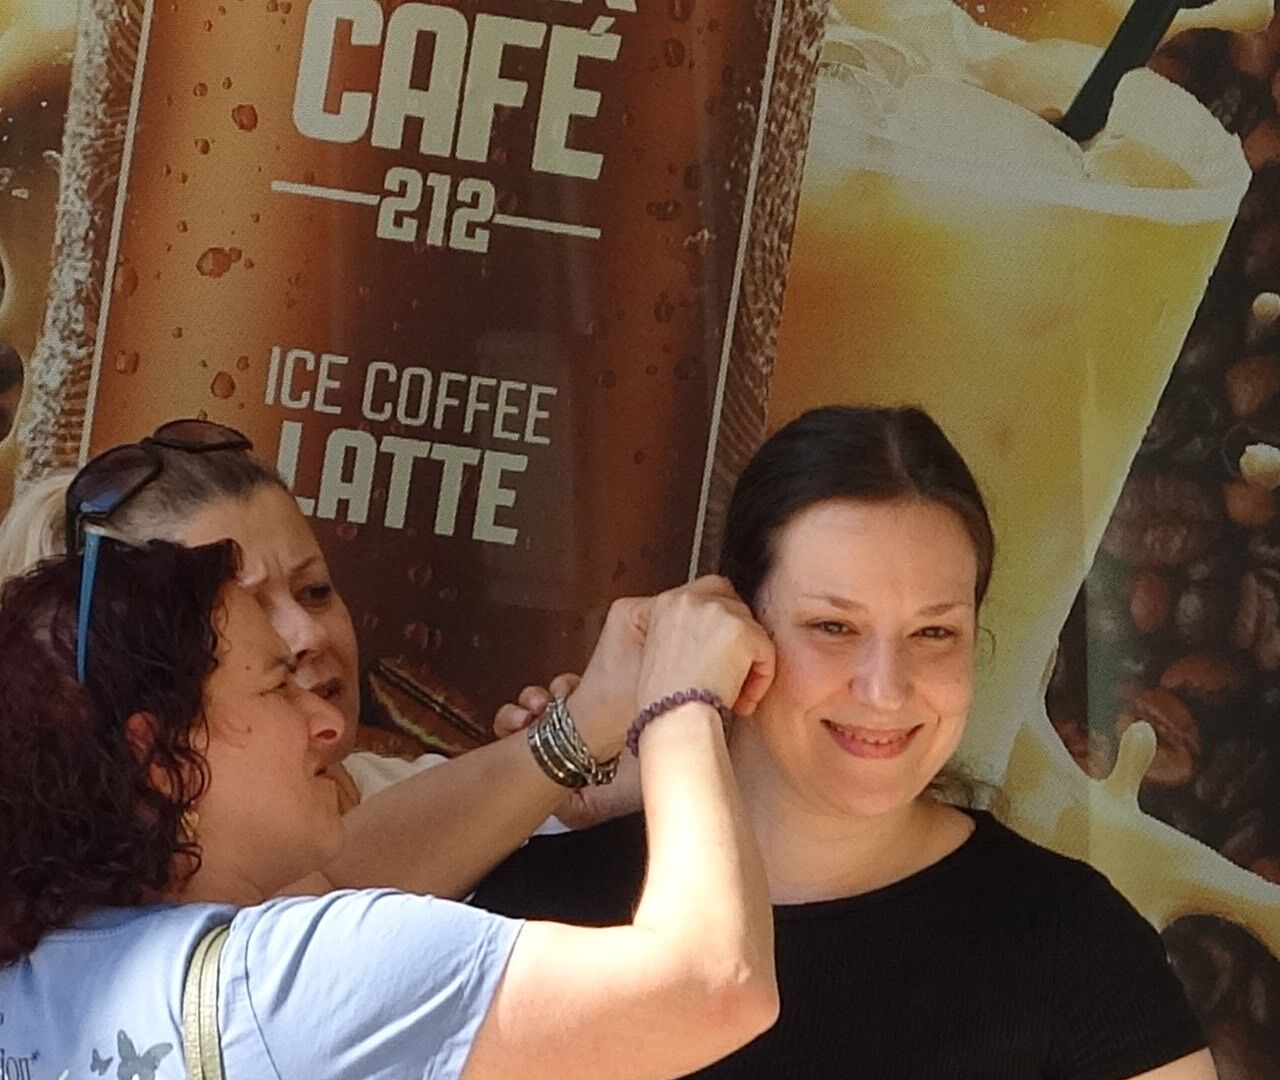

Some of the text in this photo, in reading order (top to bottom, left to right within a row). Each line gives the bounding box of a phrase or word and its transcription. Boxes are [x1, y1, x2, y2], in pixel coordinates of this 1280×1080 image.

[292, 0, 621, 180] CAFÉ
[376, 167, 496, 253] 212
[264, 346, 559, 445] ICE COFFEE
[277, 420, 528, 546] LATTE
